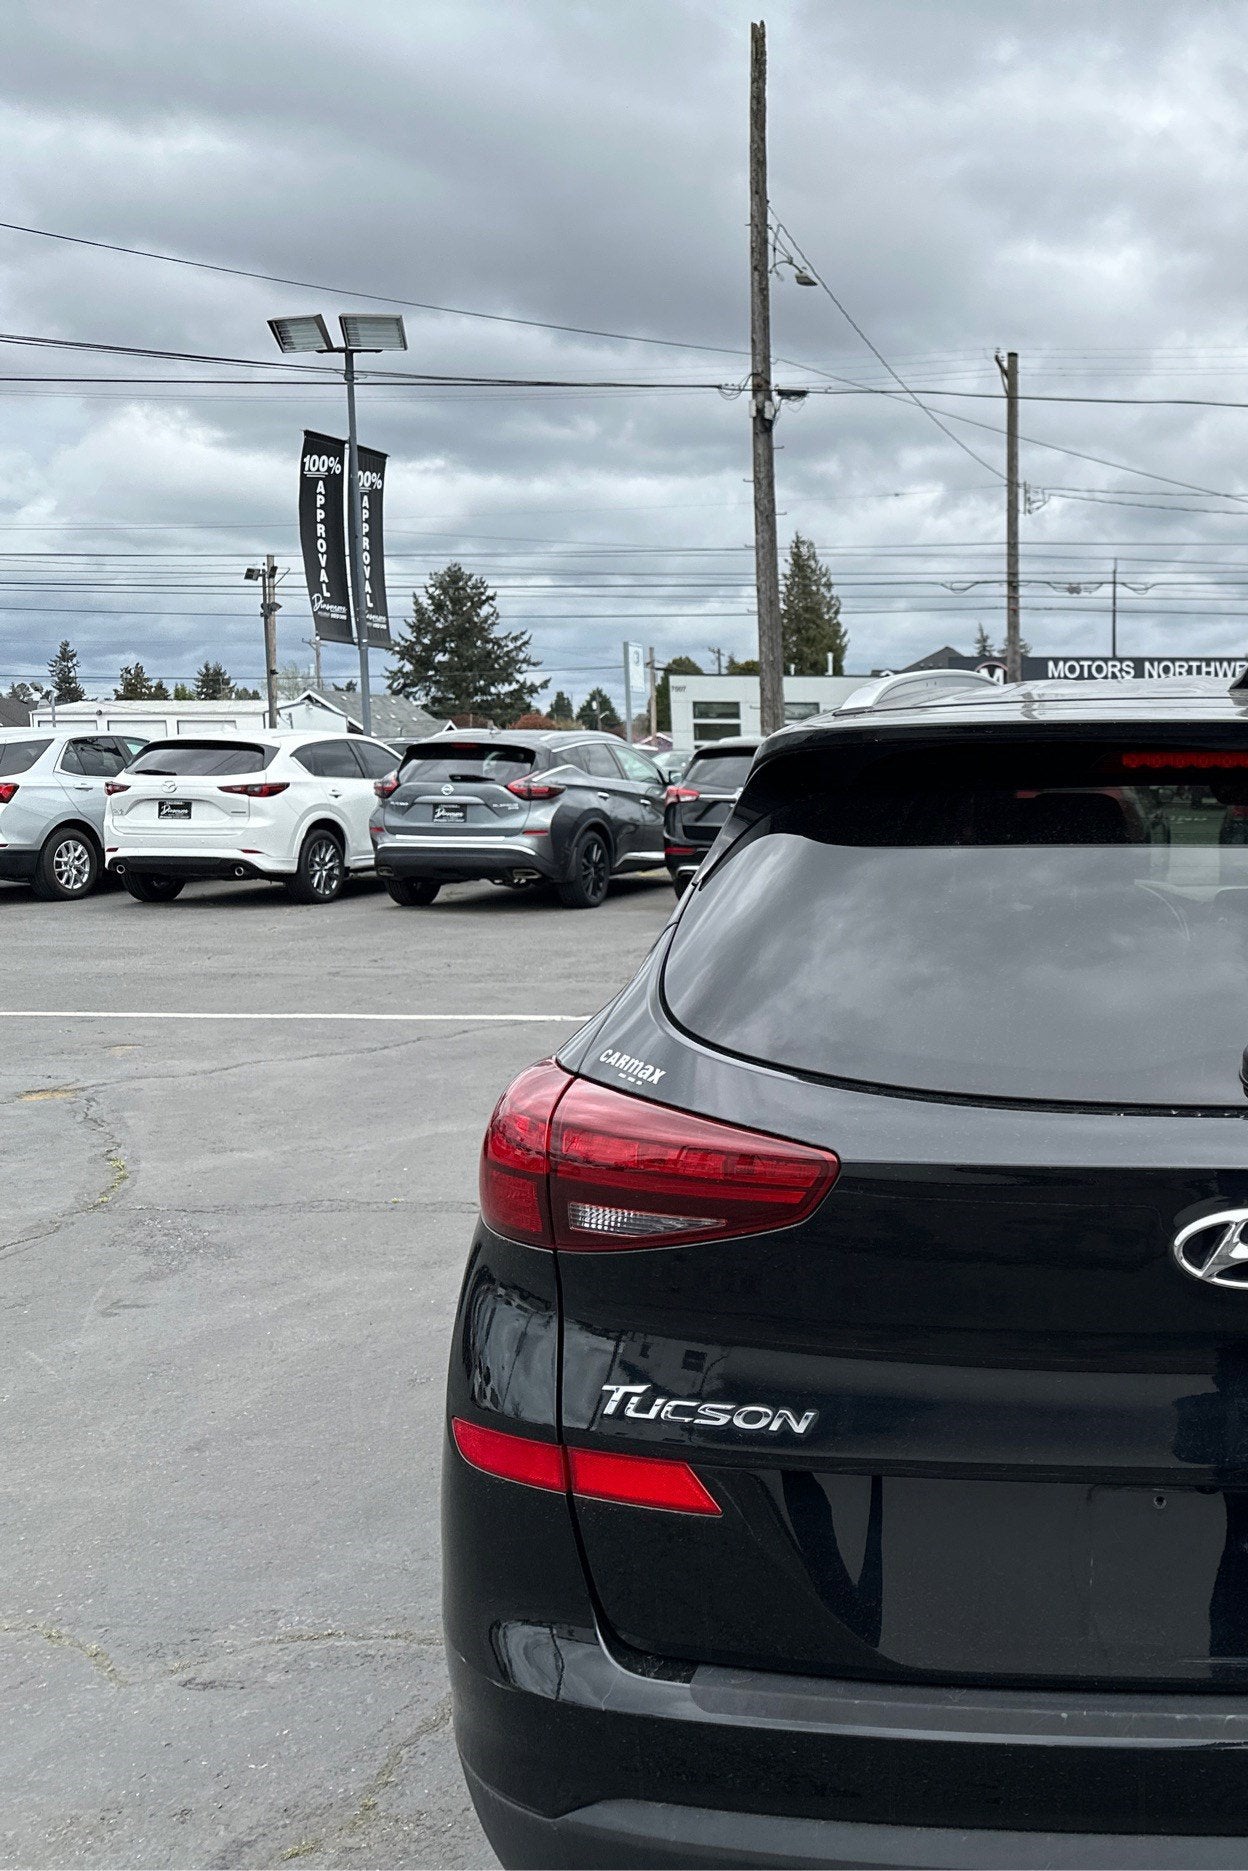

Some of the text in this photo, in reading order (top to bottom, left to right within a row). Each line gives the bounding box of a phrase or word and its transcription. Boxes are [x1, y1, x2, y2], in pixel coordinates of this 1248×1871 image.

[303, 454, 342, 475] 100%
[358, 471, 382, 490] 00%
[316, 480, 331, 598] APPROVAL
[362, 495, 374, 608] APPROVAL
[1048, 661, 1135, 680] MOTORS
[601, 1384, 819, 1434] TUCSON
